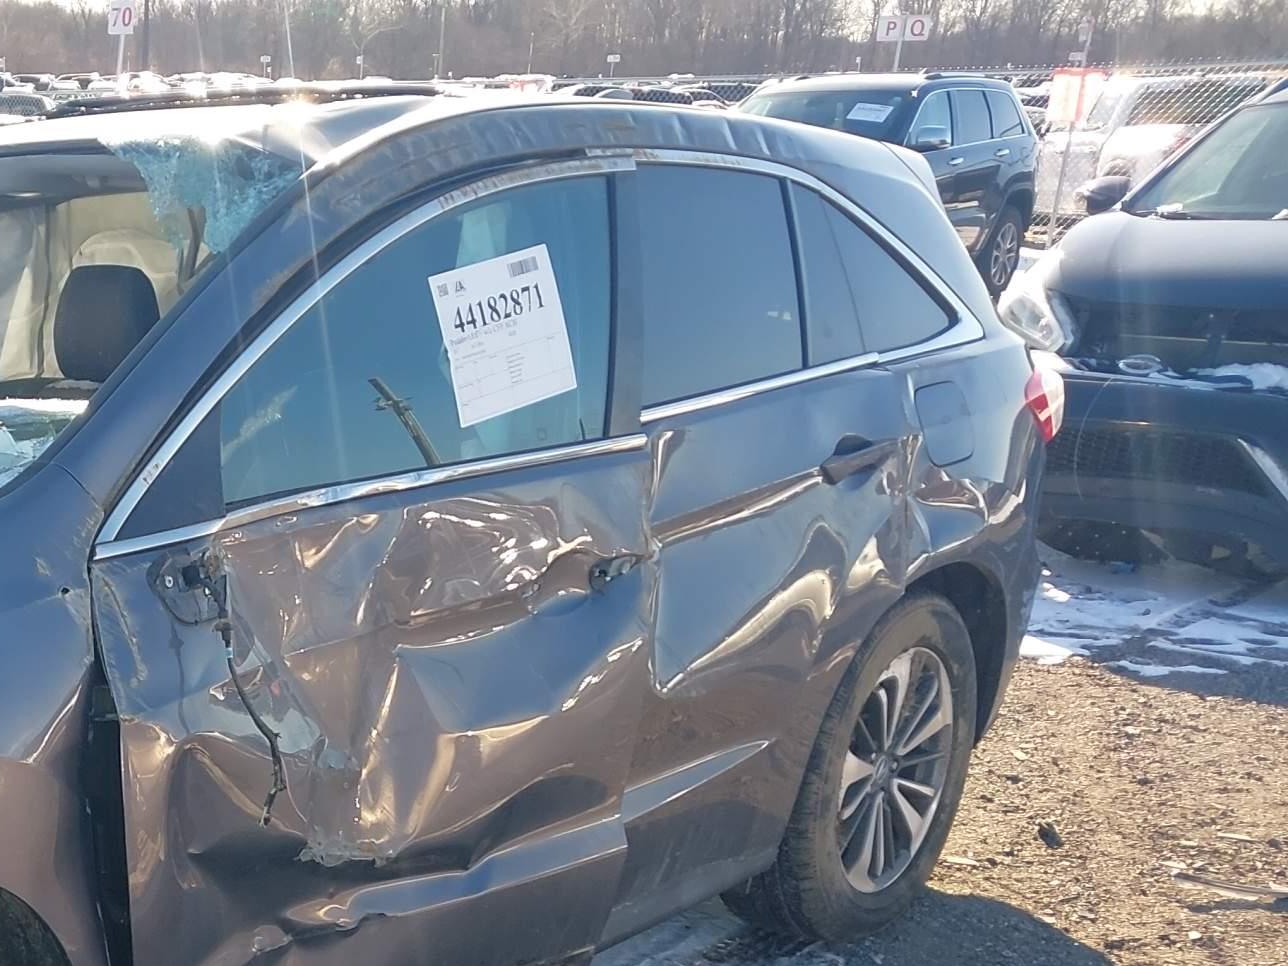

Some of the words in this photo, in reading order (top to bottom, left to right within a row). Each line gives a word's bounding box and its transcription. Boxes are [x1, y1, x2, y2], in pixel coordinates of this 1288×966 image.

[111, 7, 132, 27] 70
[885, 20, 897, 37] P
[910, 18, 925, 37] Q
[453, 281, 545, 333] 44182871
